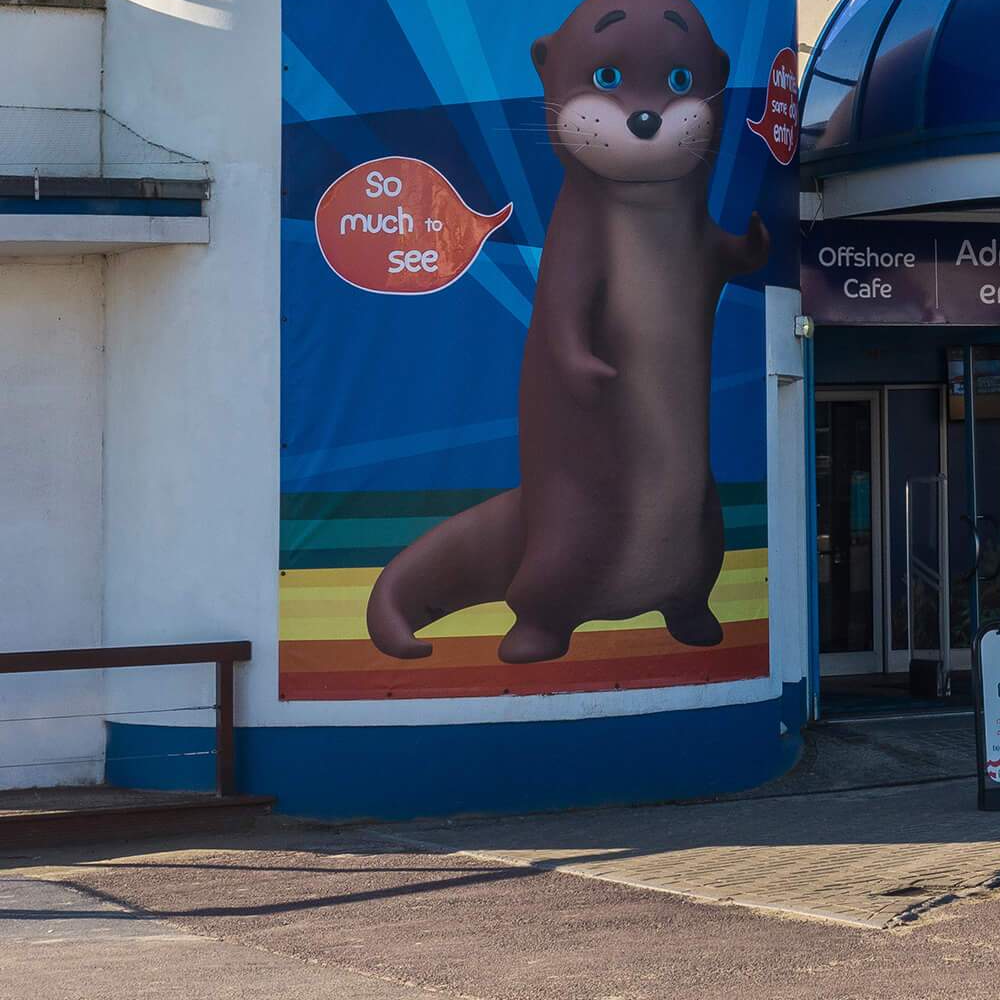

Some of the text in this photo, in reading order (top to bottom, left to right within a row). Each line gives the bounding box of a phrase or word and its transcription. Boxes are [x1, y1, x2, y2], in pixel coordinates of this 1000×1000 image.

[771, 99, 788, 117] same
[365, 170, 402, 198] So
[340, 206, 443, 235] much to
[388, 249, 439, 273] see
[818, 246, 916, 268] Offshore
[843, 277, 893, 299] Cafe
